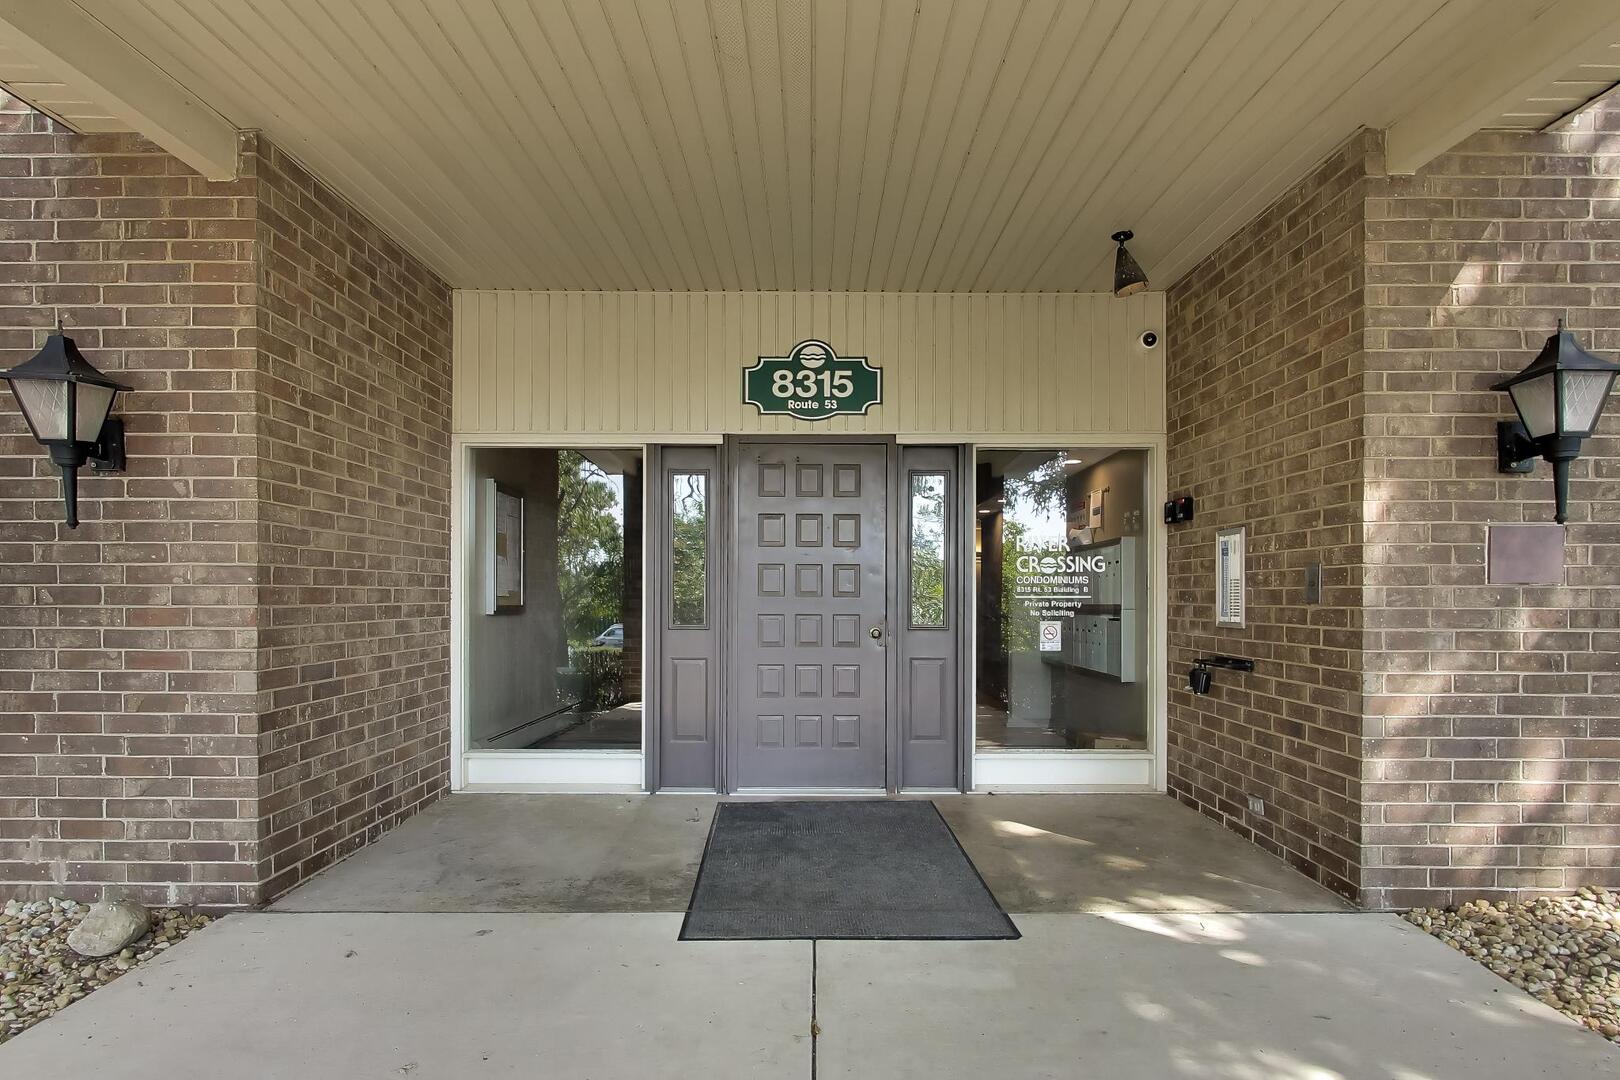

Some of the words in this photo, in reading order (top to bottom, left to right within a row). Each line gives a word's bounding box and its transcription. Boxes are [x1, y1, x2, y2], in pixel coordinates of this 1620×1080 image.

[771, 369, 854, 398] 8315
[788, 400, 819, 409] Route
[824, 400, 838, 409] 53
[1016, 556, 1106, 574] CROSSING
[1016, 576, 1089, 584] CONDOMINIUMS
[1024, 600, 1049, 608] Private
[1051, 600, 1082, 608] Property
[1041, 609, 1075, 618] Soliciting
